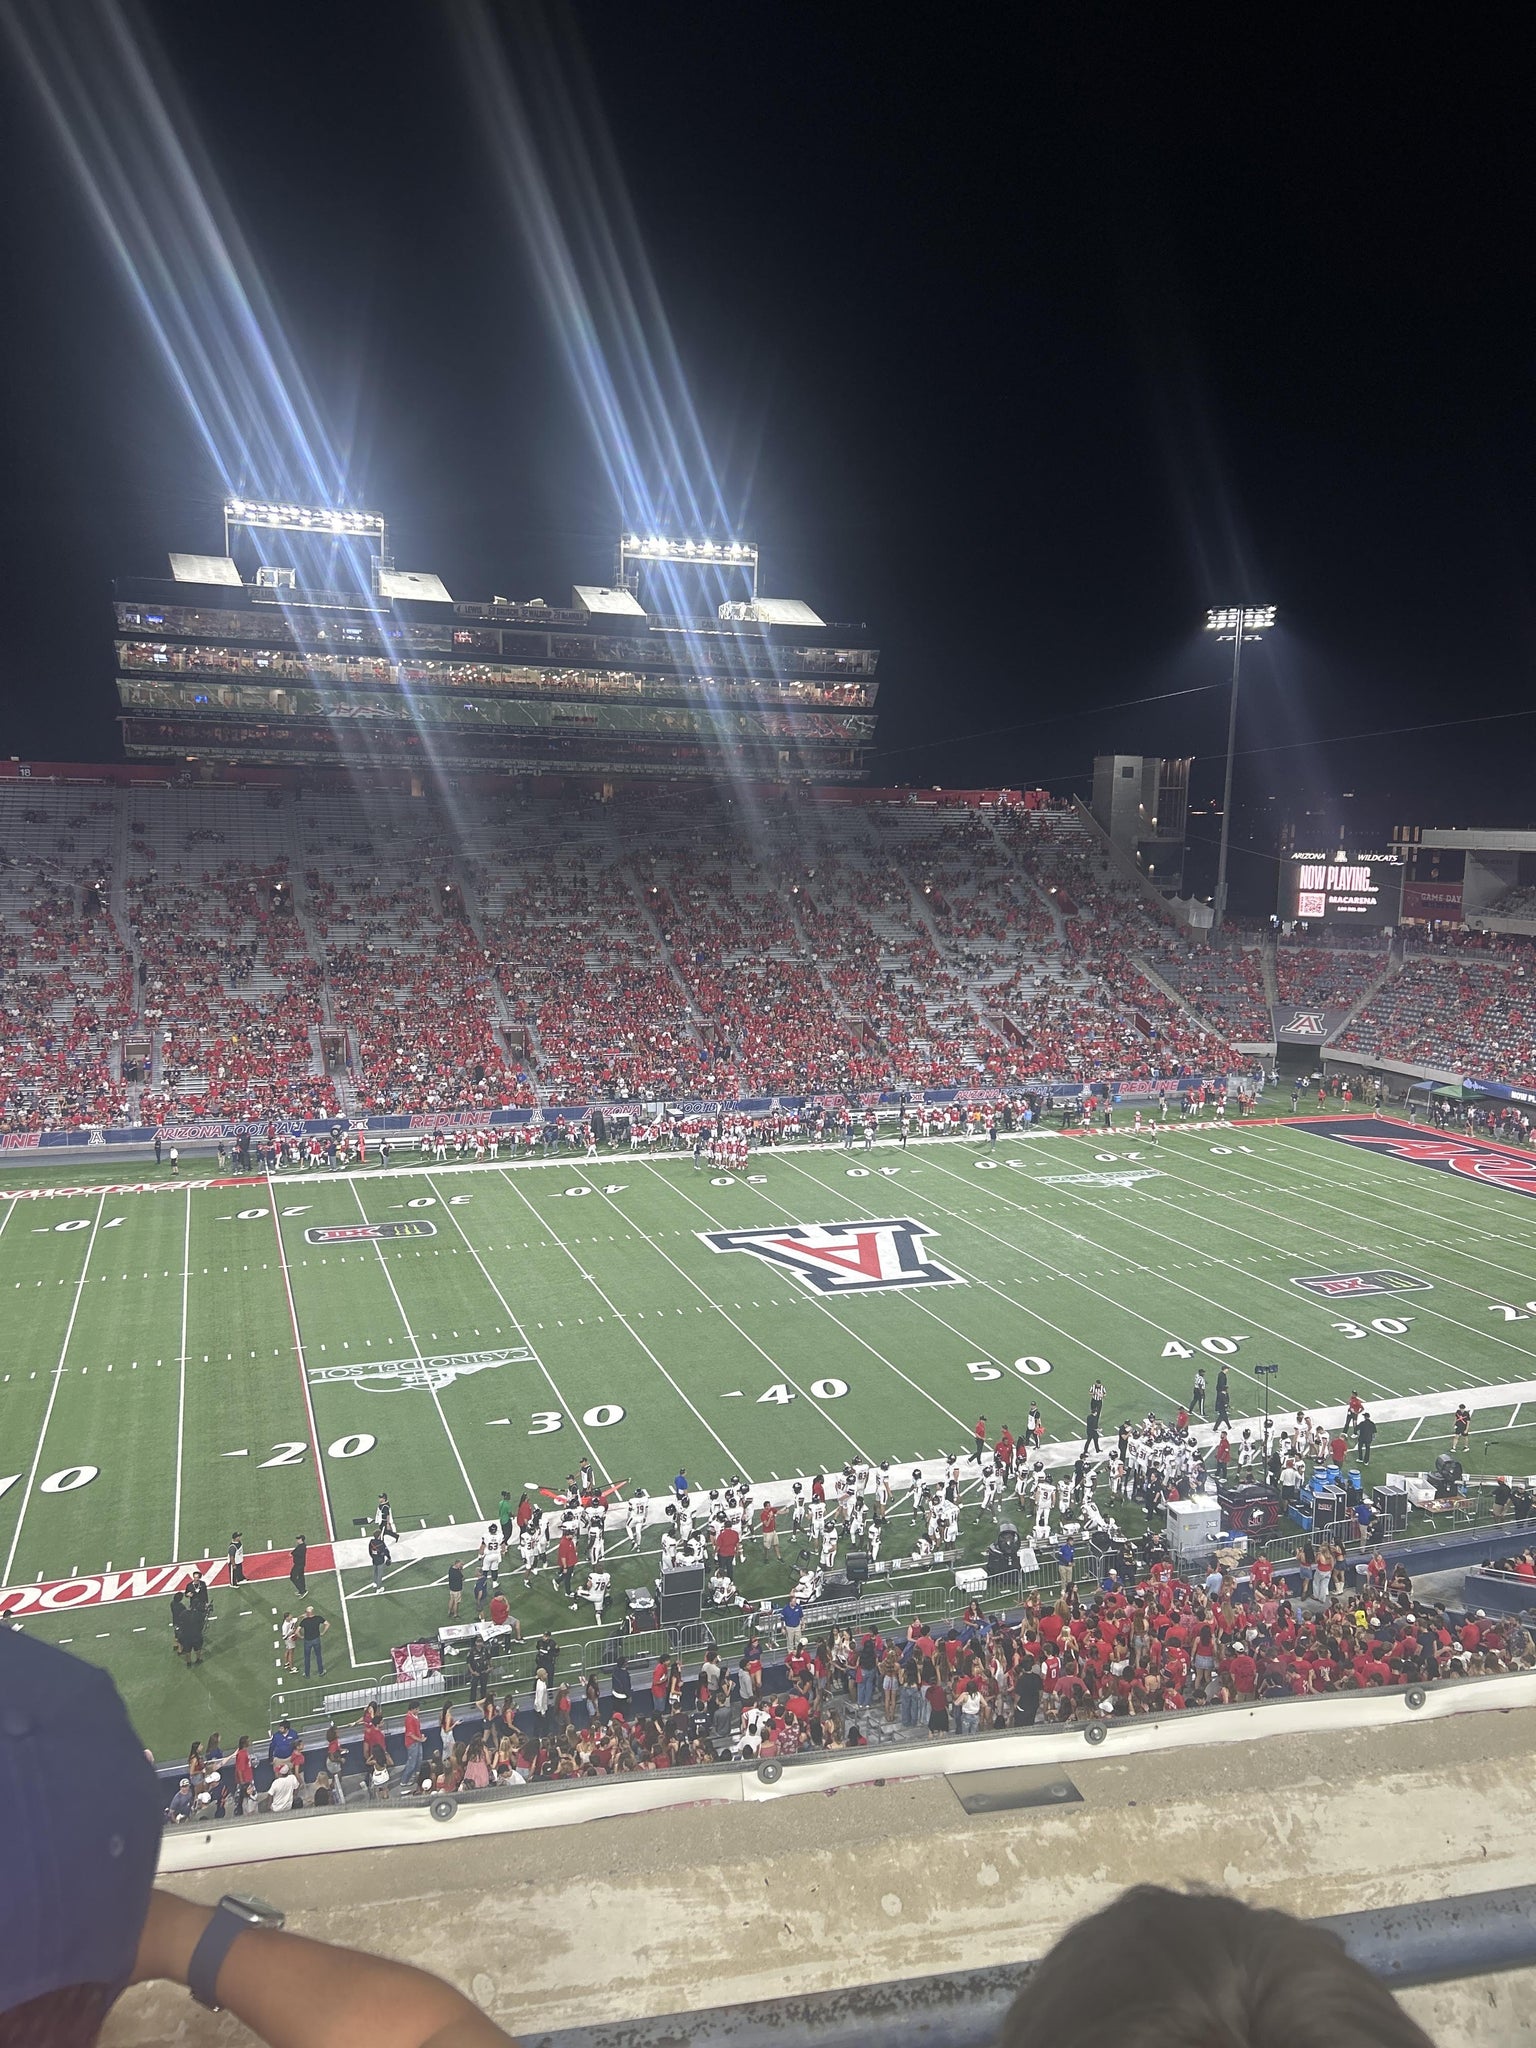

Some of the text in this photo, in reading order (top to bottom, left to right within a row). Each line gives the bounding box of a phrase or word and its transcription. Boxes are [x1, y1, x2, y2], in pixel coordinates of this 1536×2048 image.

[20, 769, 31, 777] 18
[1358, 854, 1399, 862] WILDCATS
[1300, 865, 1326, 889] NOW
[1328, 896, 1377, 905] MACARENA
[953, 1089, 1000, 1100] ARIZONA
[1118, 1080, 1179, 1094] REDLINE
[1511, 1091, 1527, 1101] NOW
[410, 1112, 491, 1129] REDLINE
[151, 1124, 222, 1140] ARIZONA
[1330, 1318, 1408, 1339] 30
[1161, 1336, 1238, 1359] 40
[310, 1350, 530, 1379] CASINO DEL SOL
[966, 1356, 1052, 1382] 50
[756, 1378, 849, 1405] 40
[527, 1404, 625, 1435] 30
[256, 1433, 376, 1469] 20
[636, 1506, 645, 1514] 19
[487, 1542, 499, 1551] 63
[594, 1581, 606, 1591] 78
